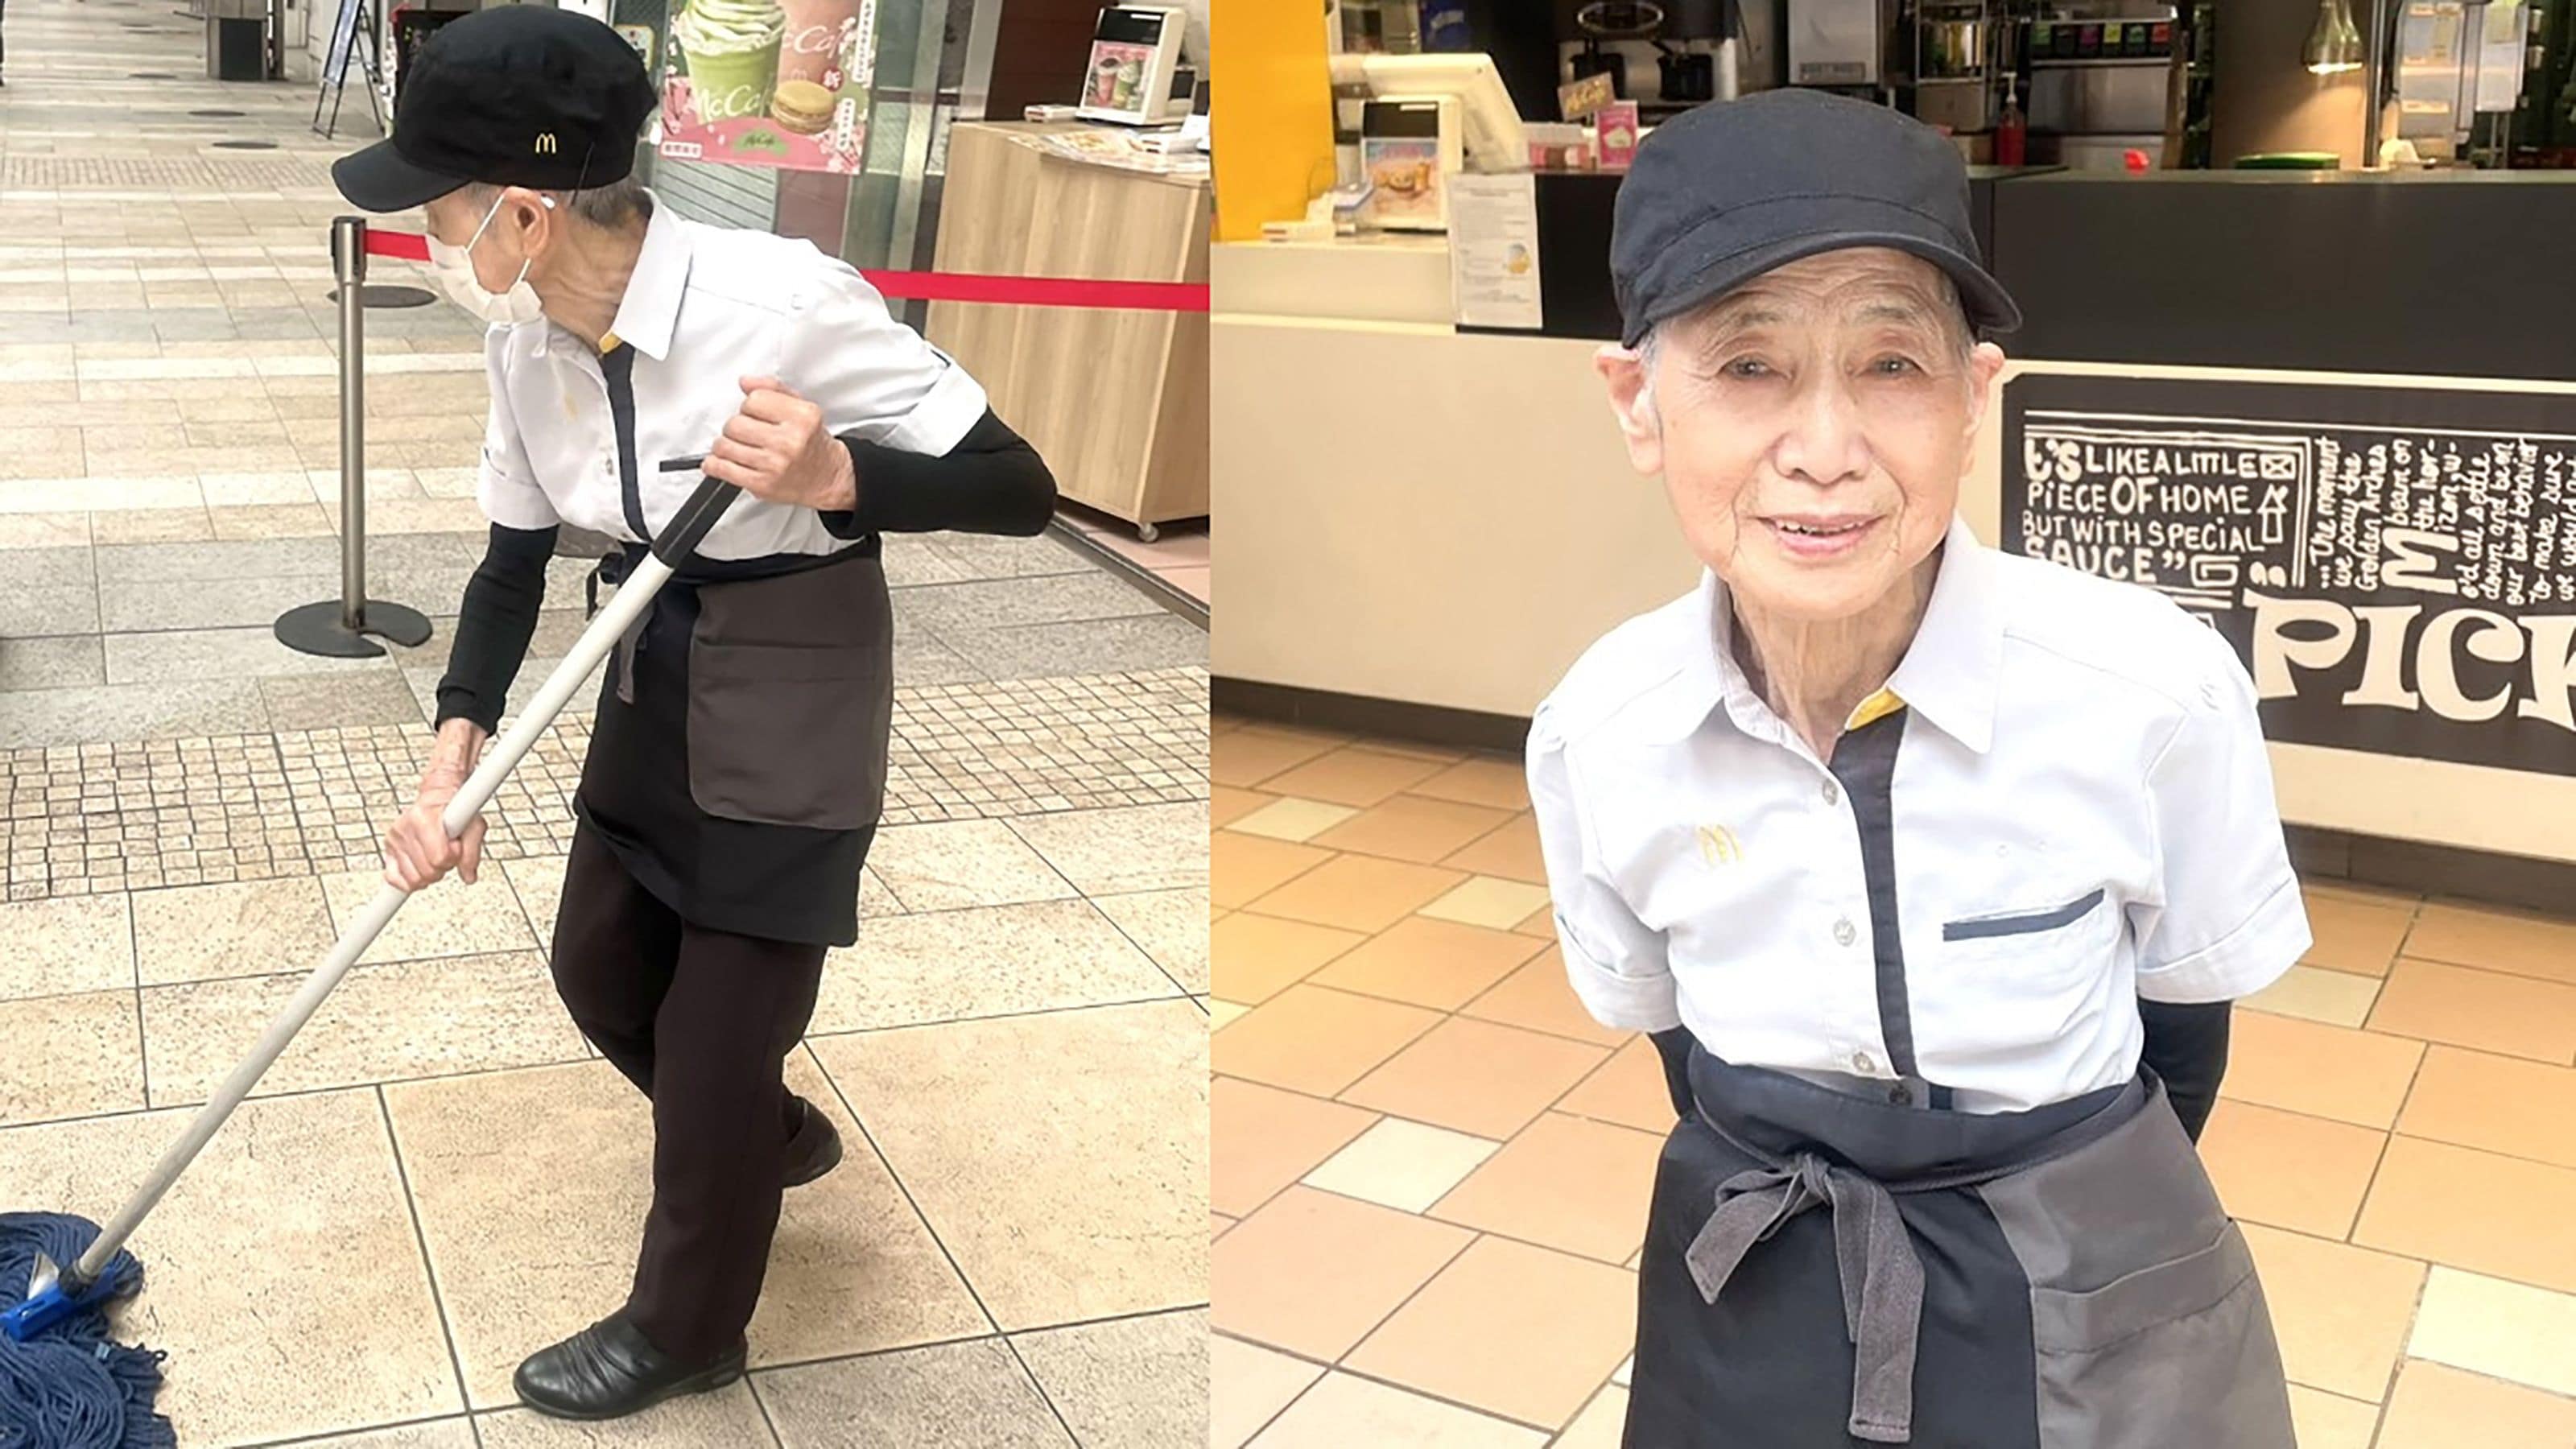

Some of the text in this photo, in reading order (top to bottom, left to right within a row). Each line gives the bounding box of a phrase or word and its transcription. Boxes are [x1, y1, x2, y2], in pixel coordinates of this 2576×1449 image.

[2085, 445, 2150, 474] LIKE
[2153, 448, 2171, 474] A
[2175, 451, 2258, 478] LITTLE
[2314, 436, 2340, 515] moment
[2490, 466, 2510, 491] be
[2111, 476, 2159, 514] OF
[2161, 485, 2251, 514] HOME
[2384, 439, 2413, 526] beam on
[2461, 452, 2490, 522] settle
[2023, 510, 2066, 536] BUT
[2333, 452, 2362, 587] we saw the
[2354, 444, 2387, 592] Golden Arches
[2412, 494, 2435, 531] the
[2486, 499, 2508, 536] and
[2529, 452, 2563, 605] to make sure
[2461, 526, 2484, 560] all
[2479, 542, 2505, 601] down
[2506, 567, 2524, 605] our
